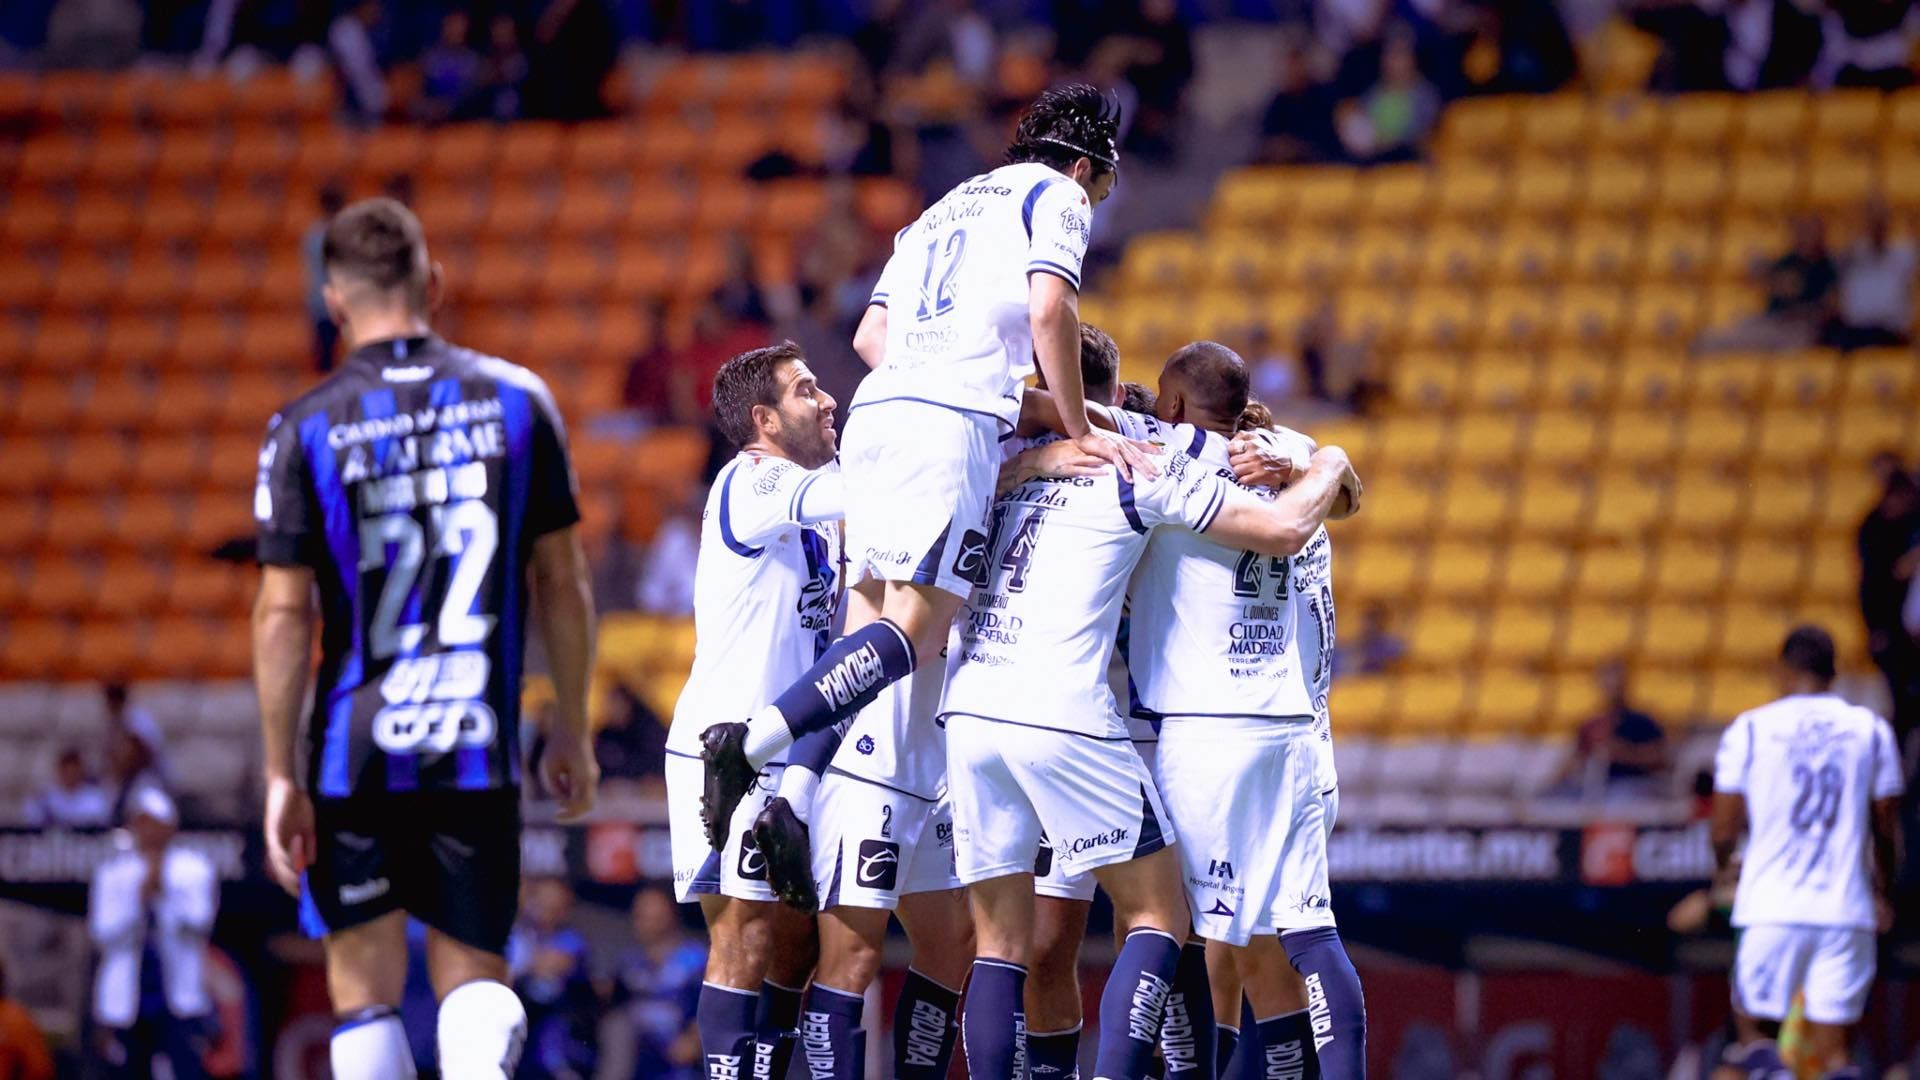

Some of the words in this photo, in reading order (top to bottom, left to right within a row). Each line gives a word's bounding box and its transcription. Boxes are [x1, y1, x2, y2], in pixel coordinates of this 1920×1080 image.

[916, 228, 967, 322] 12
[360, 497, 500, 661] 22
[974, 502, 1049, 593] 14
[1232, 549, 1291, 600] 24
[1228, 640, 1286, 655] MADERAS
[1229, 622, 1284, 640] CIUDAD
[814, 640, 885, 713] PERDURA
[881, 804, 892, 839] 2
[1110, 828, 1129, 845] Jr.
[1189, 876, 1220, 889] Hospital
[904, 999, 947, 1067] ERDURA
[1127, 970, 1170, 1044] PERDURA
[1160, 992, 1198, 1073] PERDURA
[802, 1010, 835, 1080] PERDURA
